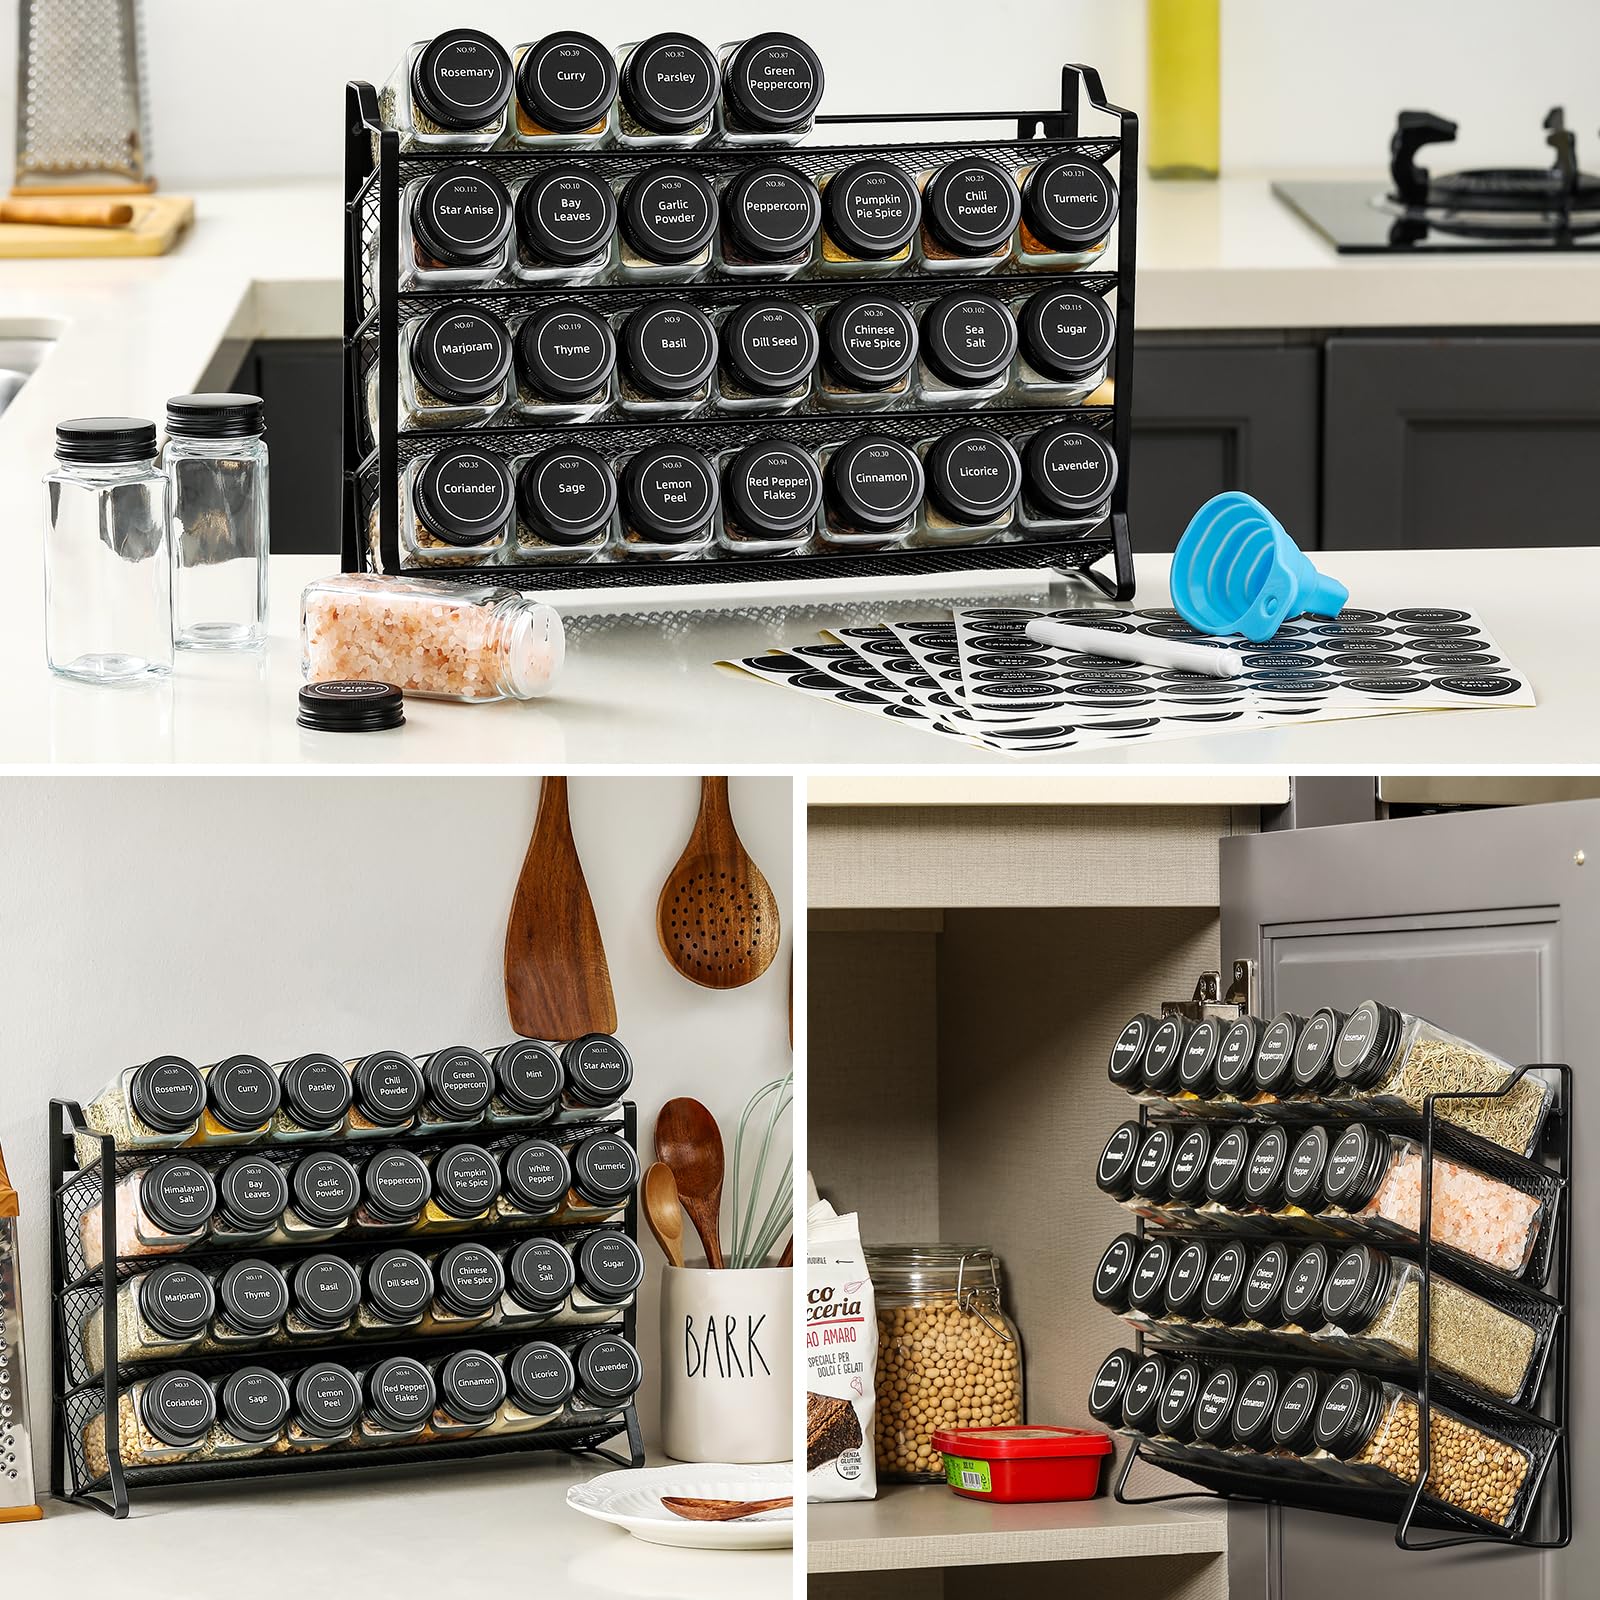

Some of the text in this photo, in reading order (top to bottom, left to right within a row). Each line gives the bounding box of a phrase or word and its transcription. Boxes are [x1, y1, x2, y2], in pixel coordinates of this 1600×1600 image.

[455, 46, 477, 54] NO.95
[559, 49, 581, 57] NO.39
[664, 50, 685, 58] NO.82
[768, 51, 789, 59] NO.87
[440, 67, 495, 79] Rosemary
[763, 65, 796, 76] Green
[556, 70, 586, 83] Curry
[656, 71, 696, 84] Parsley
[749, 79, 811, 92] Peppercorn
[964, 174, 985, 183] NO.25
[1062, 170, 1085, 178] NO.121
[559, 182, 581, 190] NO.10
[661, 181, 682, 190] NO.50
[765, 180, 786, 188] NO.86
[866, 177, 887, 185] NO.93
[453, 185, 478, 193] NO.112
[854, 193, 901, 207] Pumpkin
[965, 190, 988, 202] Chili
[1052, 192, 1099, 204] Turmeric
[560, 198, 582, 210] Bay
[658, 199, 689, 211] Garlic
[746, 201, 808, 213] Peppercorn
[439, 204, 495, 215] Star Anise
[856, 208, 903, 220] Pie Spice
[957, 203, 998, 216] Powder
[553, 211, 592, 222] Leaves
[654, 212, 696, 225] Powder
[961, 306, 985, 314] NO.102
[1059, 303, 1083, 311] NO.115
[762, 314, 783, 322] NO.40
[863, 309, 884, 317] NO.26
[663, 316, 681, 324] NO.9
[453, 321, 474, 330] NO.67
[557, 322, 582, 331] NO.119
[854, 324, 895, 335] Chinese
[964, 324, 985, 335] Sea
[1056, 323, 1088, 336] Sugar
[661, 337, 688, 349] Basil
[752, 335, 798, 348] Dill Seed
[850, 337, 902, 350] Five Spice
[965, 337, 987, 348] Salt
[441, 342, 494, 355] Marjoram
[553, 344, 591, 357] Thyme
[1063, 438, 1083, 447] NO.61
[966, 444, 987, 452] NO.65
[869, 450, 890, 458] NO.30
[458, 461, 480, 469] NO.35
[559, 461, 580, 470] NO.97
[661, 461, 683, 470] NO.63
[767, 458, 788, 466] NO.94
[1051, 459, 1100, 472] Lavender
[959, 465, 999, 477] Licorice
[748, 476, 809, 489] Red Pepper
[855, 472, 908, 484] Cinnamon
[443, 482, 497, 494] Coriander
[558, 483, 586, 495] Sage
[655, 480, 693, 490] Lemon
[663, 491, 688, 504] Peel
[763, 489, 797, 500] Flakes
[583, 1061, 621, 1070] Star Anise
[452, 1071, 476, 1080] Green
[525, 1070, 543, 1079] Mint
[384, 1075, 401, 1086] Chili
[154, 1084, 194, 1095] Rosemary
[237, 1084, 259, 1094] Curry
[307, 1082, 336, 1092] Parsley
[379, 1086, 409, 1096] Powder
[444, 1081, 488, 1092] Peppercorn
[528, 1164, 551, 1173] White
[593, 1161, 626, 1171] Turmeric
[453, 1168, 487, 1179] Pumpkin
[316, 1178, 340, 1188] Garlic
[378, 1177, 422, 1187] Peppercorn
[455, 1178, 489, 1189] Pie Spice
[527, 1175, 555, 1184] Pepper
[163, 1184, 206, 1195] Himalayan
[248, 1180, 264, 1190] Bay
[243, 1191, 271, 1199] Leaves
[315, 1188, 345, 1198] Powder
[178, 1194, 195, 1204] Salt
[537, 1263, 552, 1272] Sea
[602, 1259, 625, 1269] Sugar
[458, 1266, 488, 1276] Chinese
[456, 1275, 494, 1286] Five Spice
[538, 1272, 554, 1282] Salt
[319, 1282, 339, 1292] Basil
[386, 1277, 420, 1288] Dill Seed
[164, 1291, 202, 1303] Marjoram
[243, 1290, 271, 1301] Thyme
[823, 1326, 857, 1346] AMARO
[685, 1314, 771, 1378] BARK
[807, 1351, 850, 1368] SPECIALE PER
[594, 1362, 629, 1373] Lavender
[817, 1362, 864, 1378] DOLCI E GELATI
[530, 1369, 559, 1380] Licorice
[457, 1377, 495, 1387] Cinnamon
[383, 1383, 427, 1394] Red Pepper
[316, 1389, 344, 1399] Lemon
[394, 1393, 419, 1402] Flakes
[165, 1398, 203, 1408] Coriander
[248, 1395, 268, 1405] Sage
[323, 1398, 342, 1408] Peel
